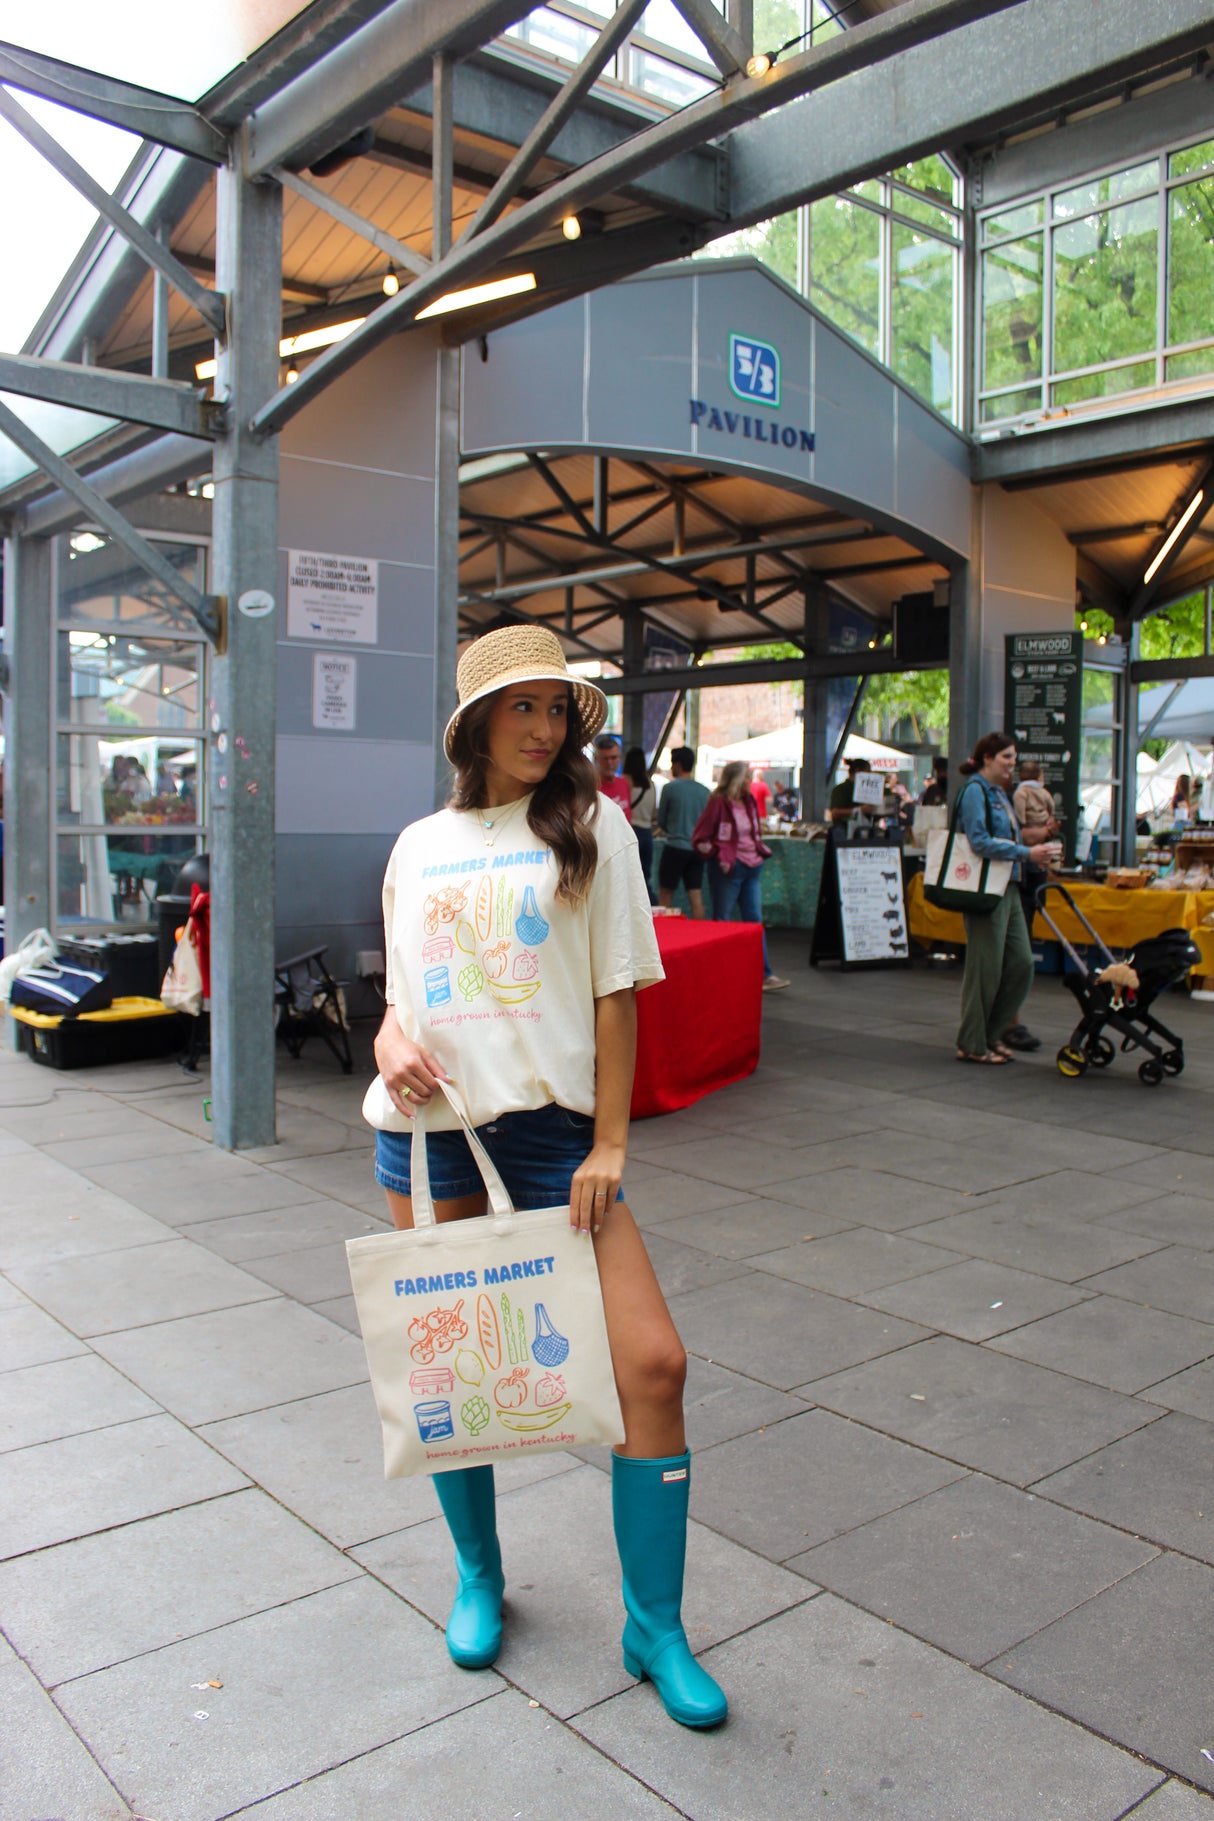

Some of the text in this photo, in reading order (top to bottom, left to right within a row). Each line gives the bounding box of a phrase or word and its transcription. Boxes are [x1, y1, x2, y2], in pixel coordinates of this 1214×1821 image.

[690, 400, 815, 451] PAVILION
[295, 566, 319, 577] CLOSED
[340, 561, 368, 572] PAVILION
[290, 576, 375, 595] DAILY PROHIBITED ACTIVITY
[1018, 639, 1069, 651] ELMWOOD
[871, 758, 898, 768] HEESE
[422, 857, 487, 878] FARMERS
[394, 1256, 554, 1296] FARMERS MARKET
[427, 1425, 448, 1439] jam
[503, 1441, 516, 1449] in
[520, 1432, 576, 1447] kentucky
